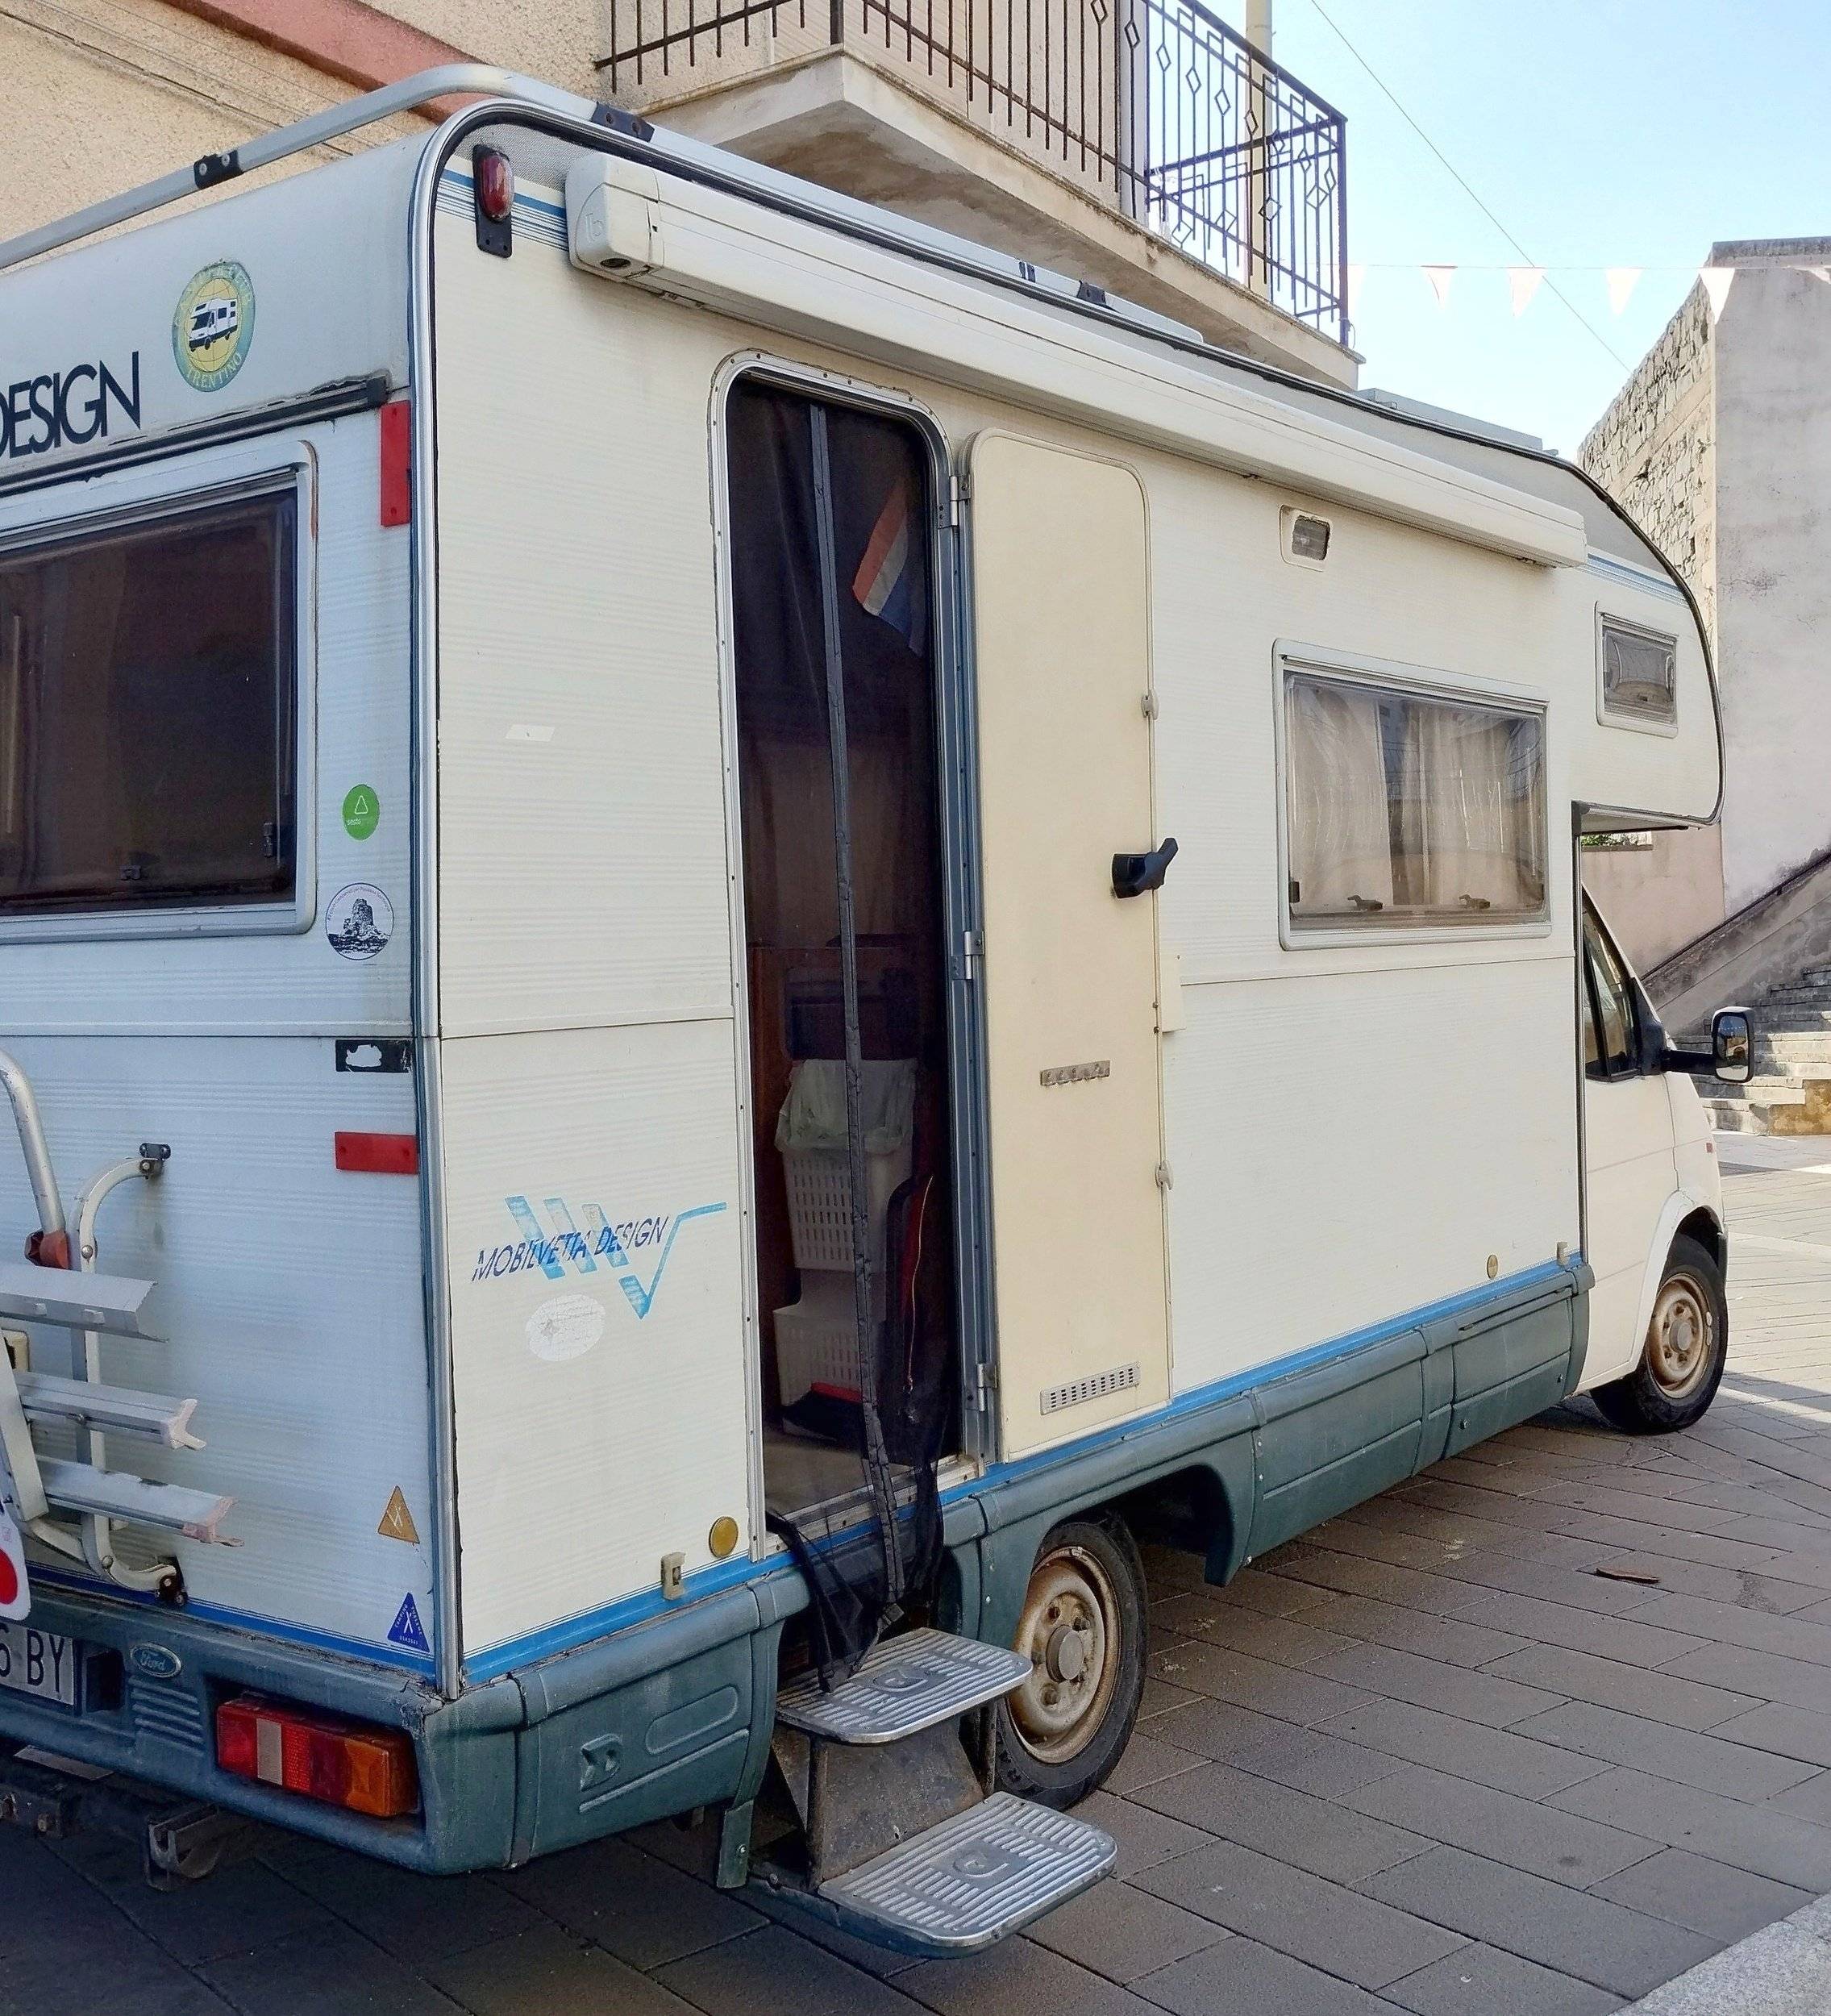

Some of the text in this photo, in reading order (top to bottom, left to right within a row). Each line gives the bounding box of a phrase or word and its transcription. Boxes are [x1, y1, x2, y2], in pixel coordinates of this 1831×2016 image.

[185, 352, 242, 388] TRENTINO
[0, 351, 140, 459] ESIGN
[594, 1216, 668, 1256] DESIGN
[27, 1629, 65, 1693] BY
[139, 1650, 167, 1671] Ford
